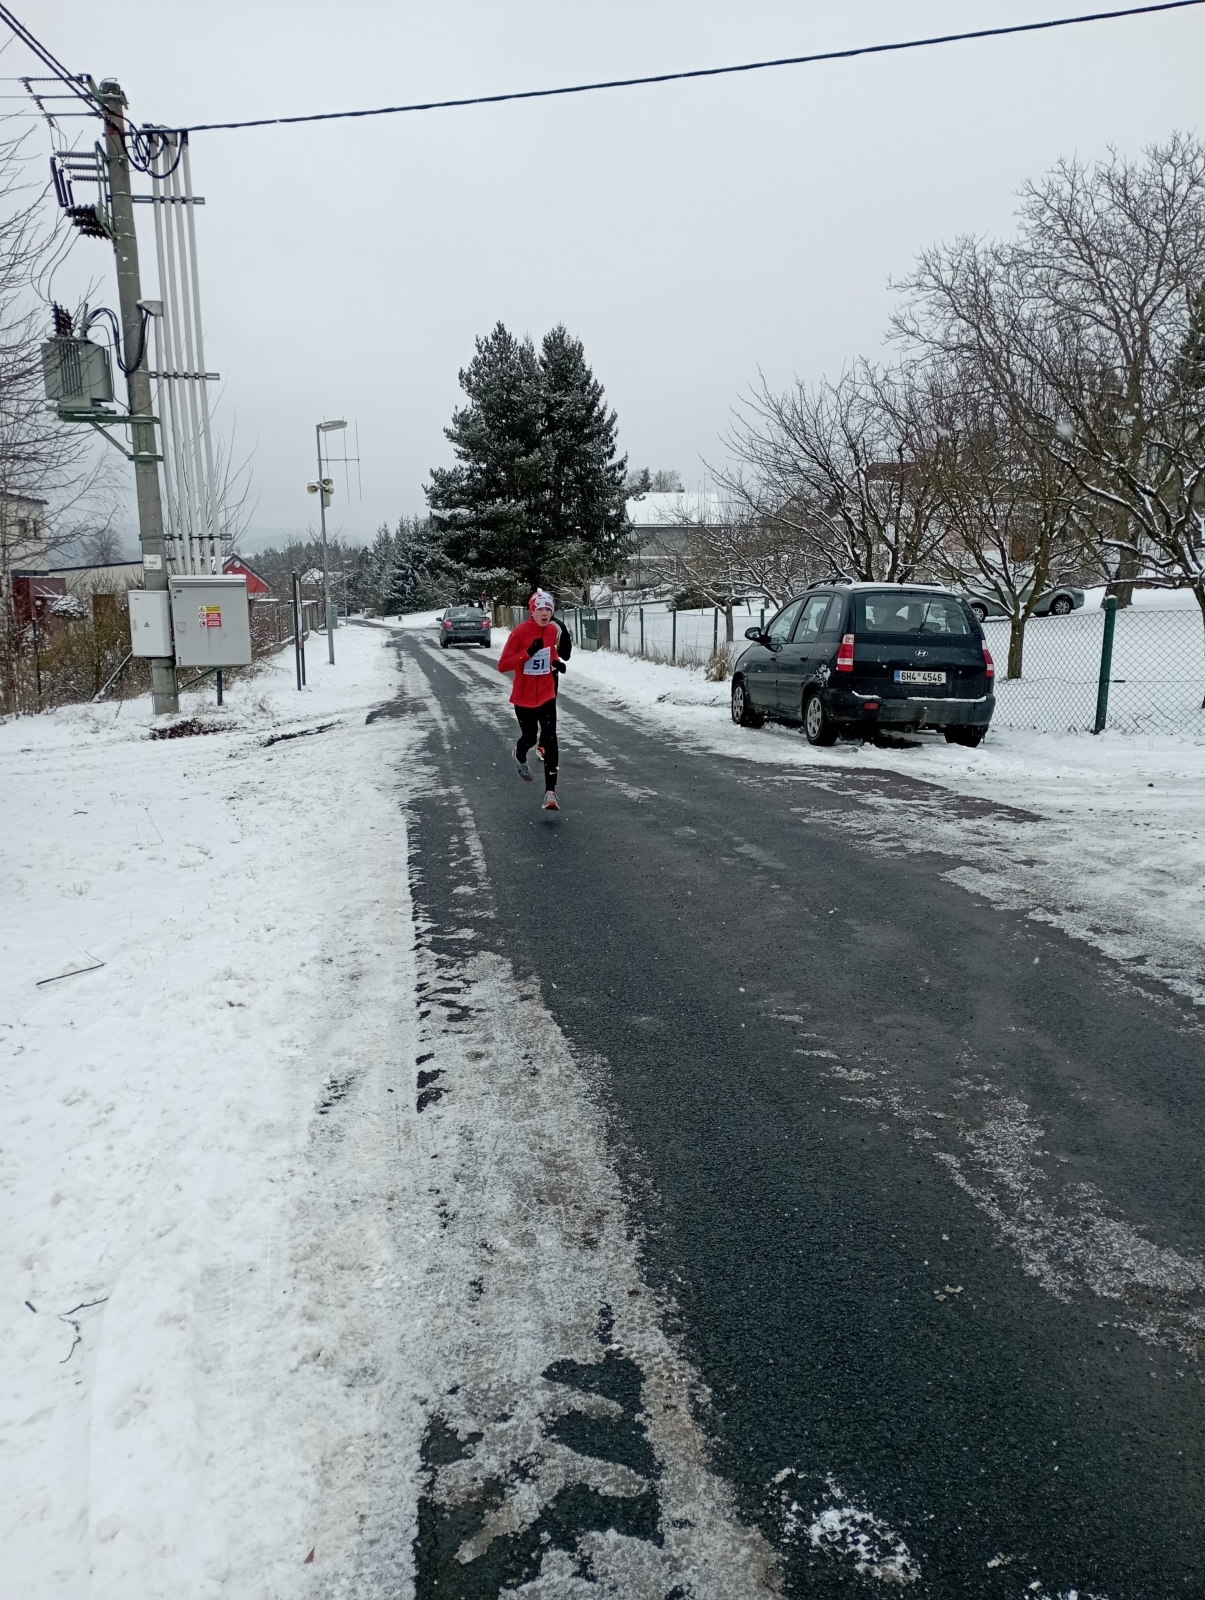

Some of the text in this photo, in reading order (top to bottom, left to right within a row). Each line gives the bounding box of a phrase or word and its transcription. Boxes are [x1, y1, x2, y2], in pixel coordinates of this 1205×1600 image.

[532, 659, 545, 670] 51
[901, 672, 943, 682] 6H4 4546
